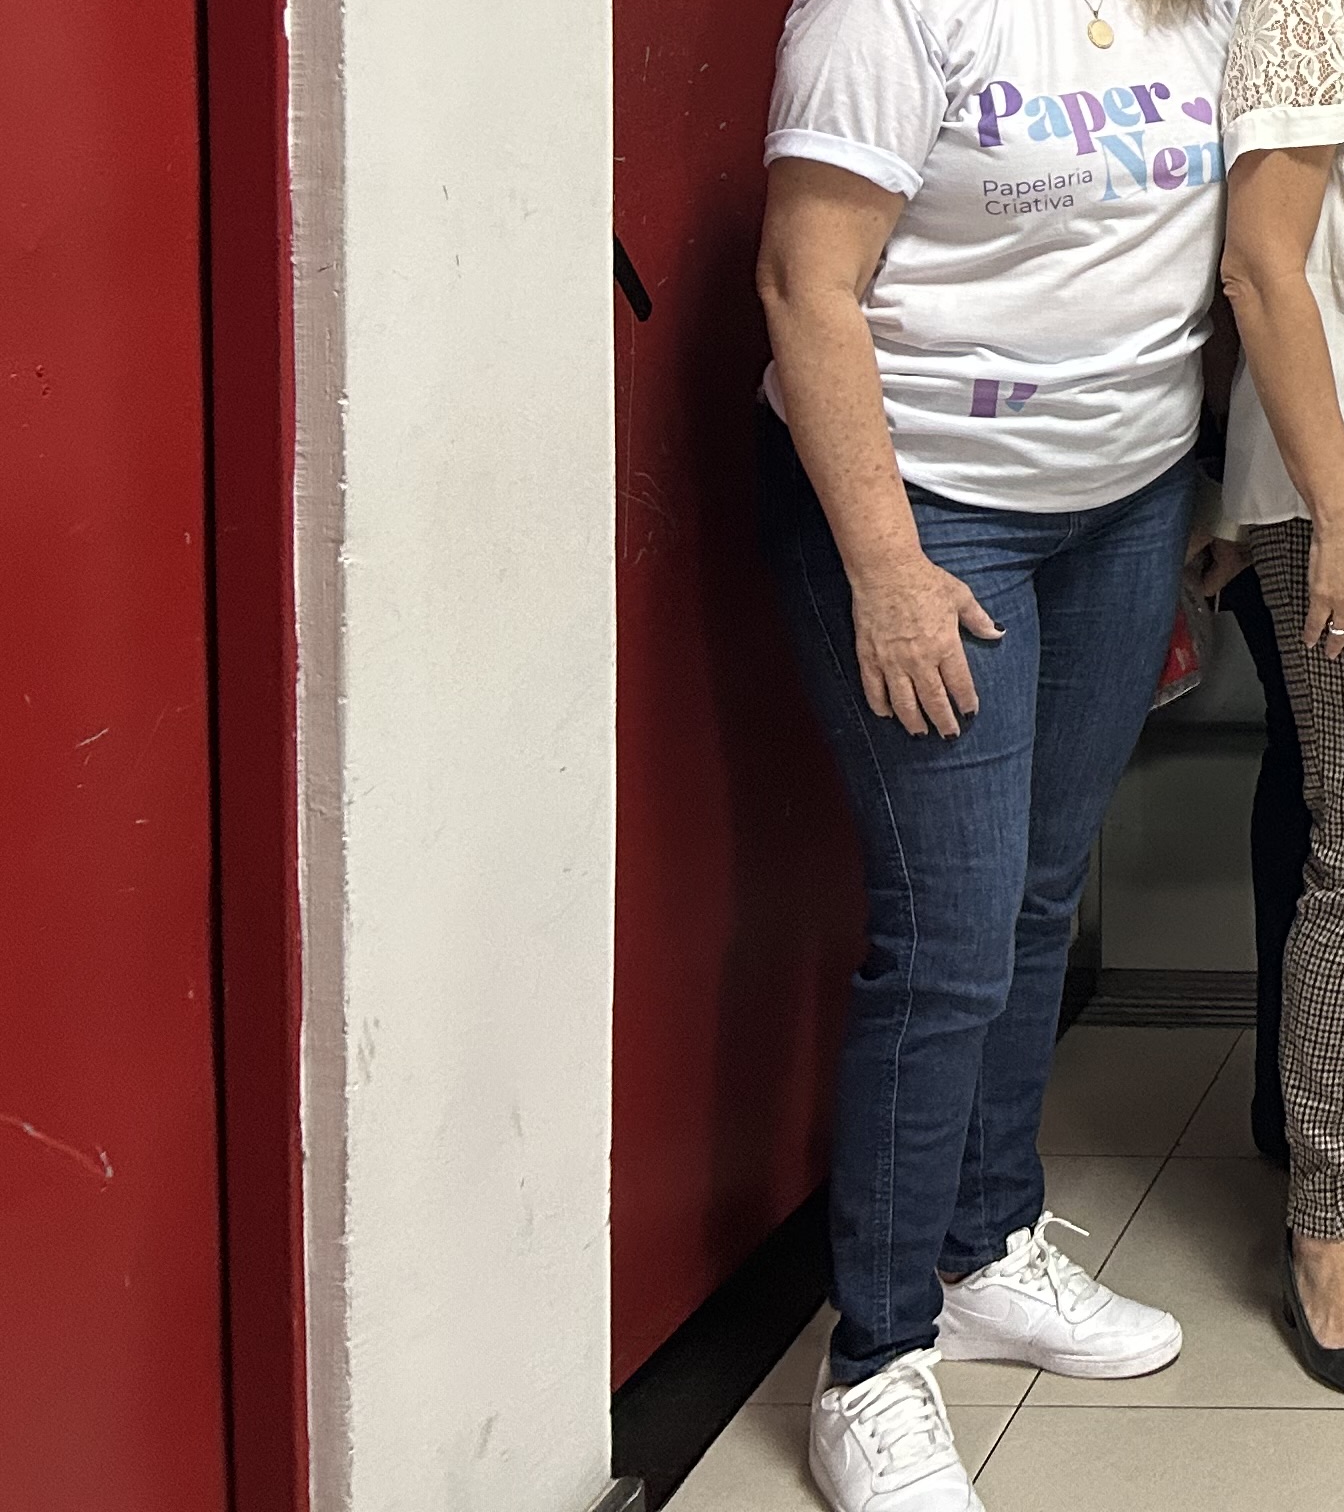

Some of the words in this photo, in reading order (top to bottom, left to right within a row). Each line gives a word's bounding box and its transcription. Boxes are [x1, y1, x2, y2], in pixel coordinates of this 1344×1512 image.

[977, 79, 1172, 156] Paper
[982, 168, 1093, 198] Papelaria
[985, 193, 1075, 217] Criativa
